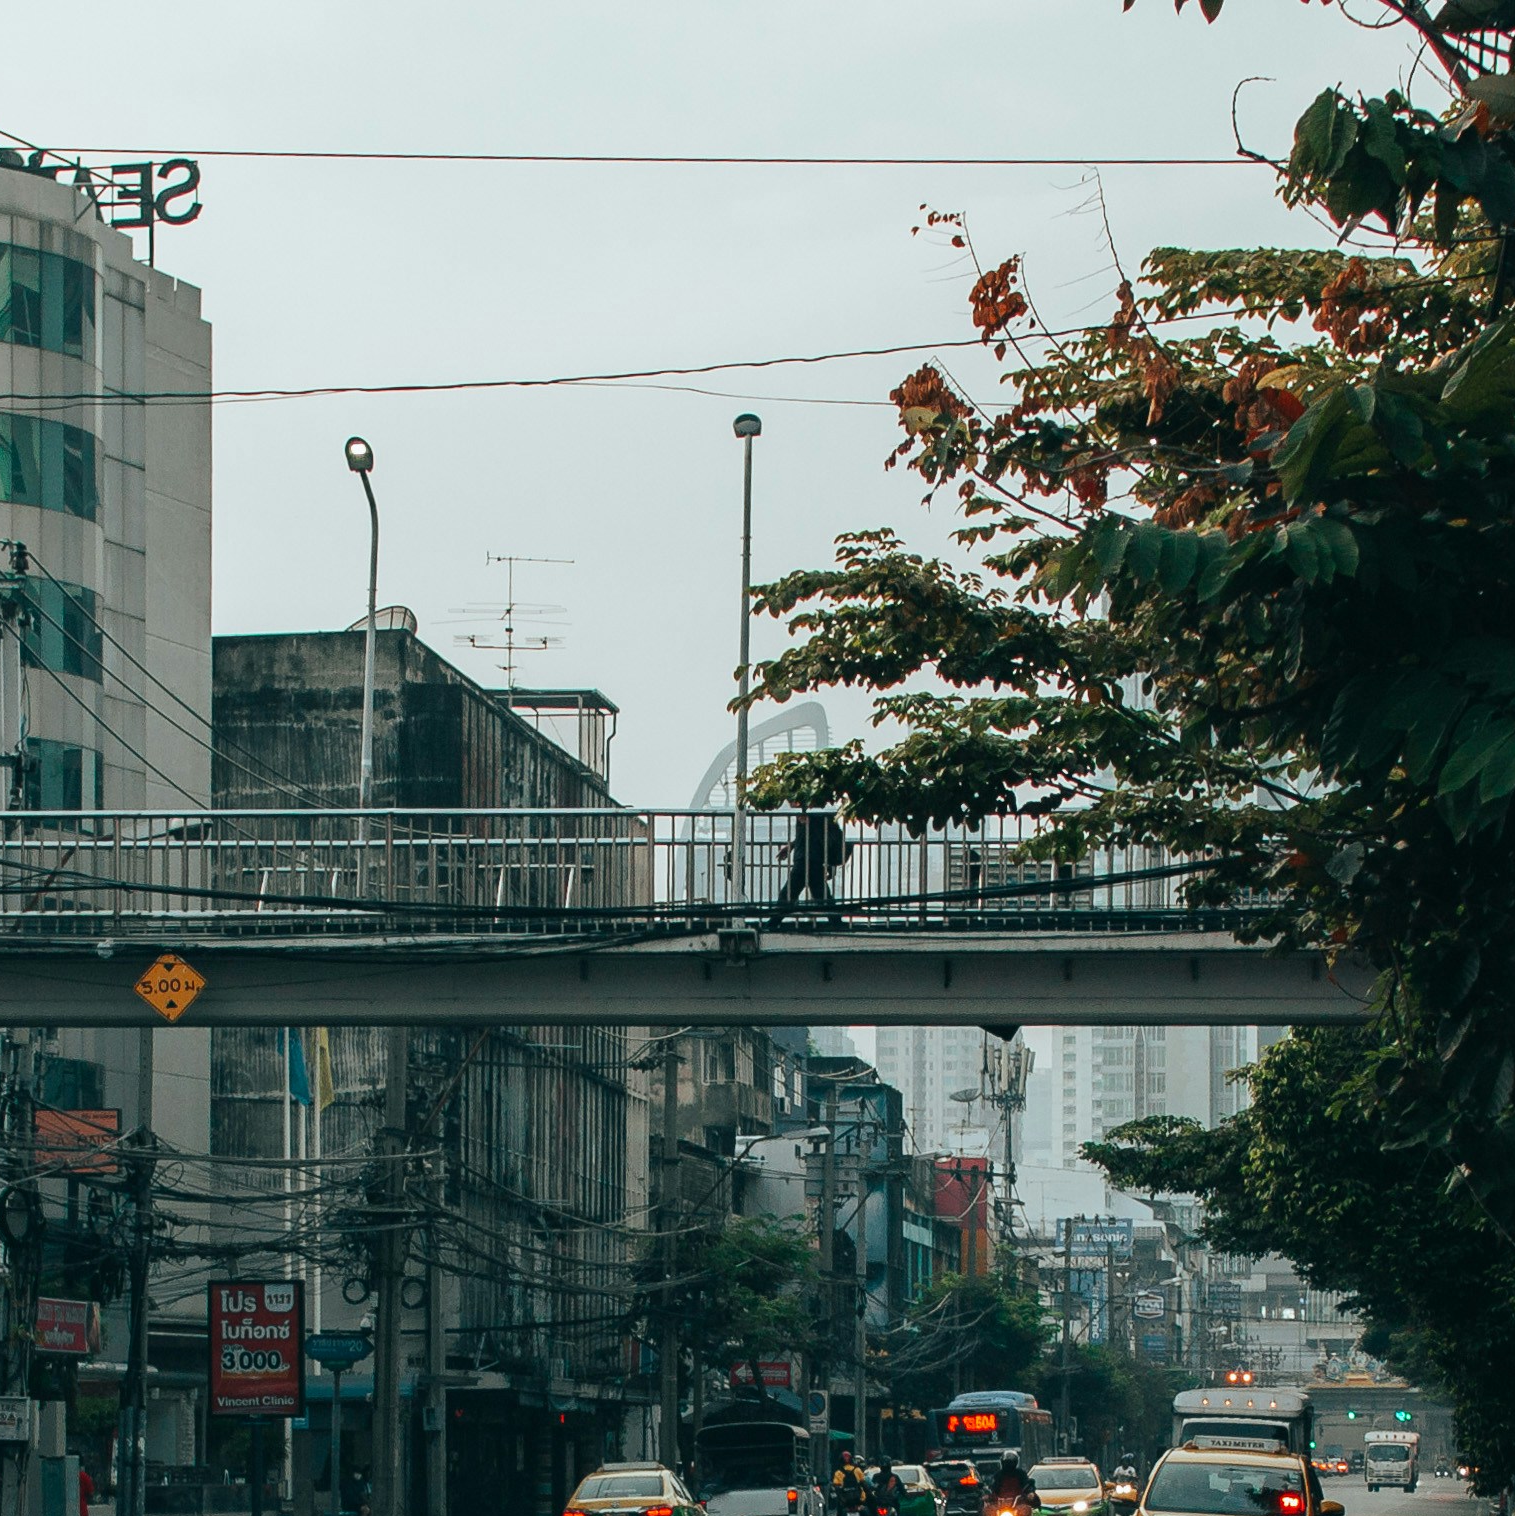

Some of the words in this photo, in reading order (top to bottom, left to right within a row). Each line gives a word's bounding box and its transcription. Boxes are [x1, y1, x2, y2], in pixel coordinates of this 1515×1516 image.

[141, 979, 181, 995] 5.00
[1060, 1230, 1128, 1242] Pnsonic
[221, 1290, 257, 1312] โปร
[218, 1396, 260, 1407] Vincent
[262, 1395, 295, 1405] Clinic
